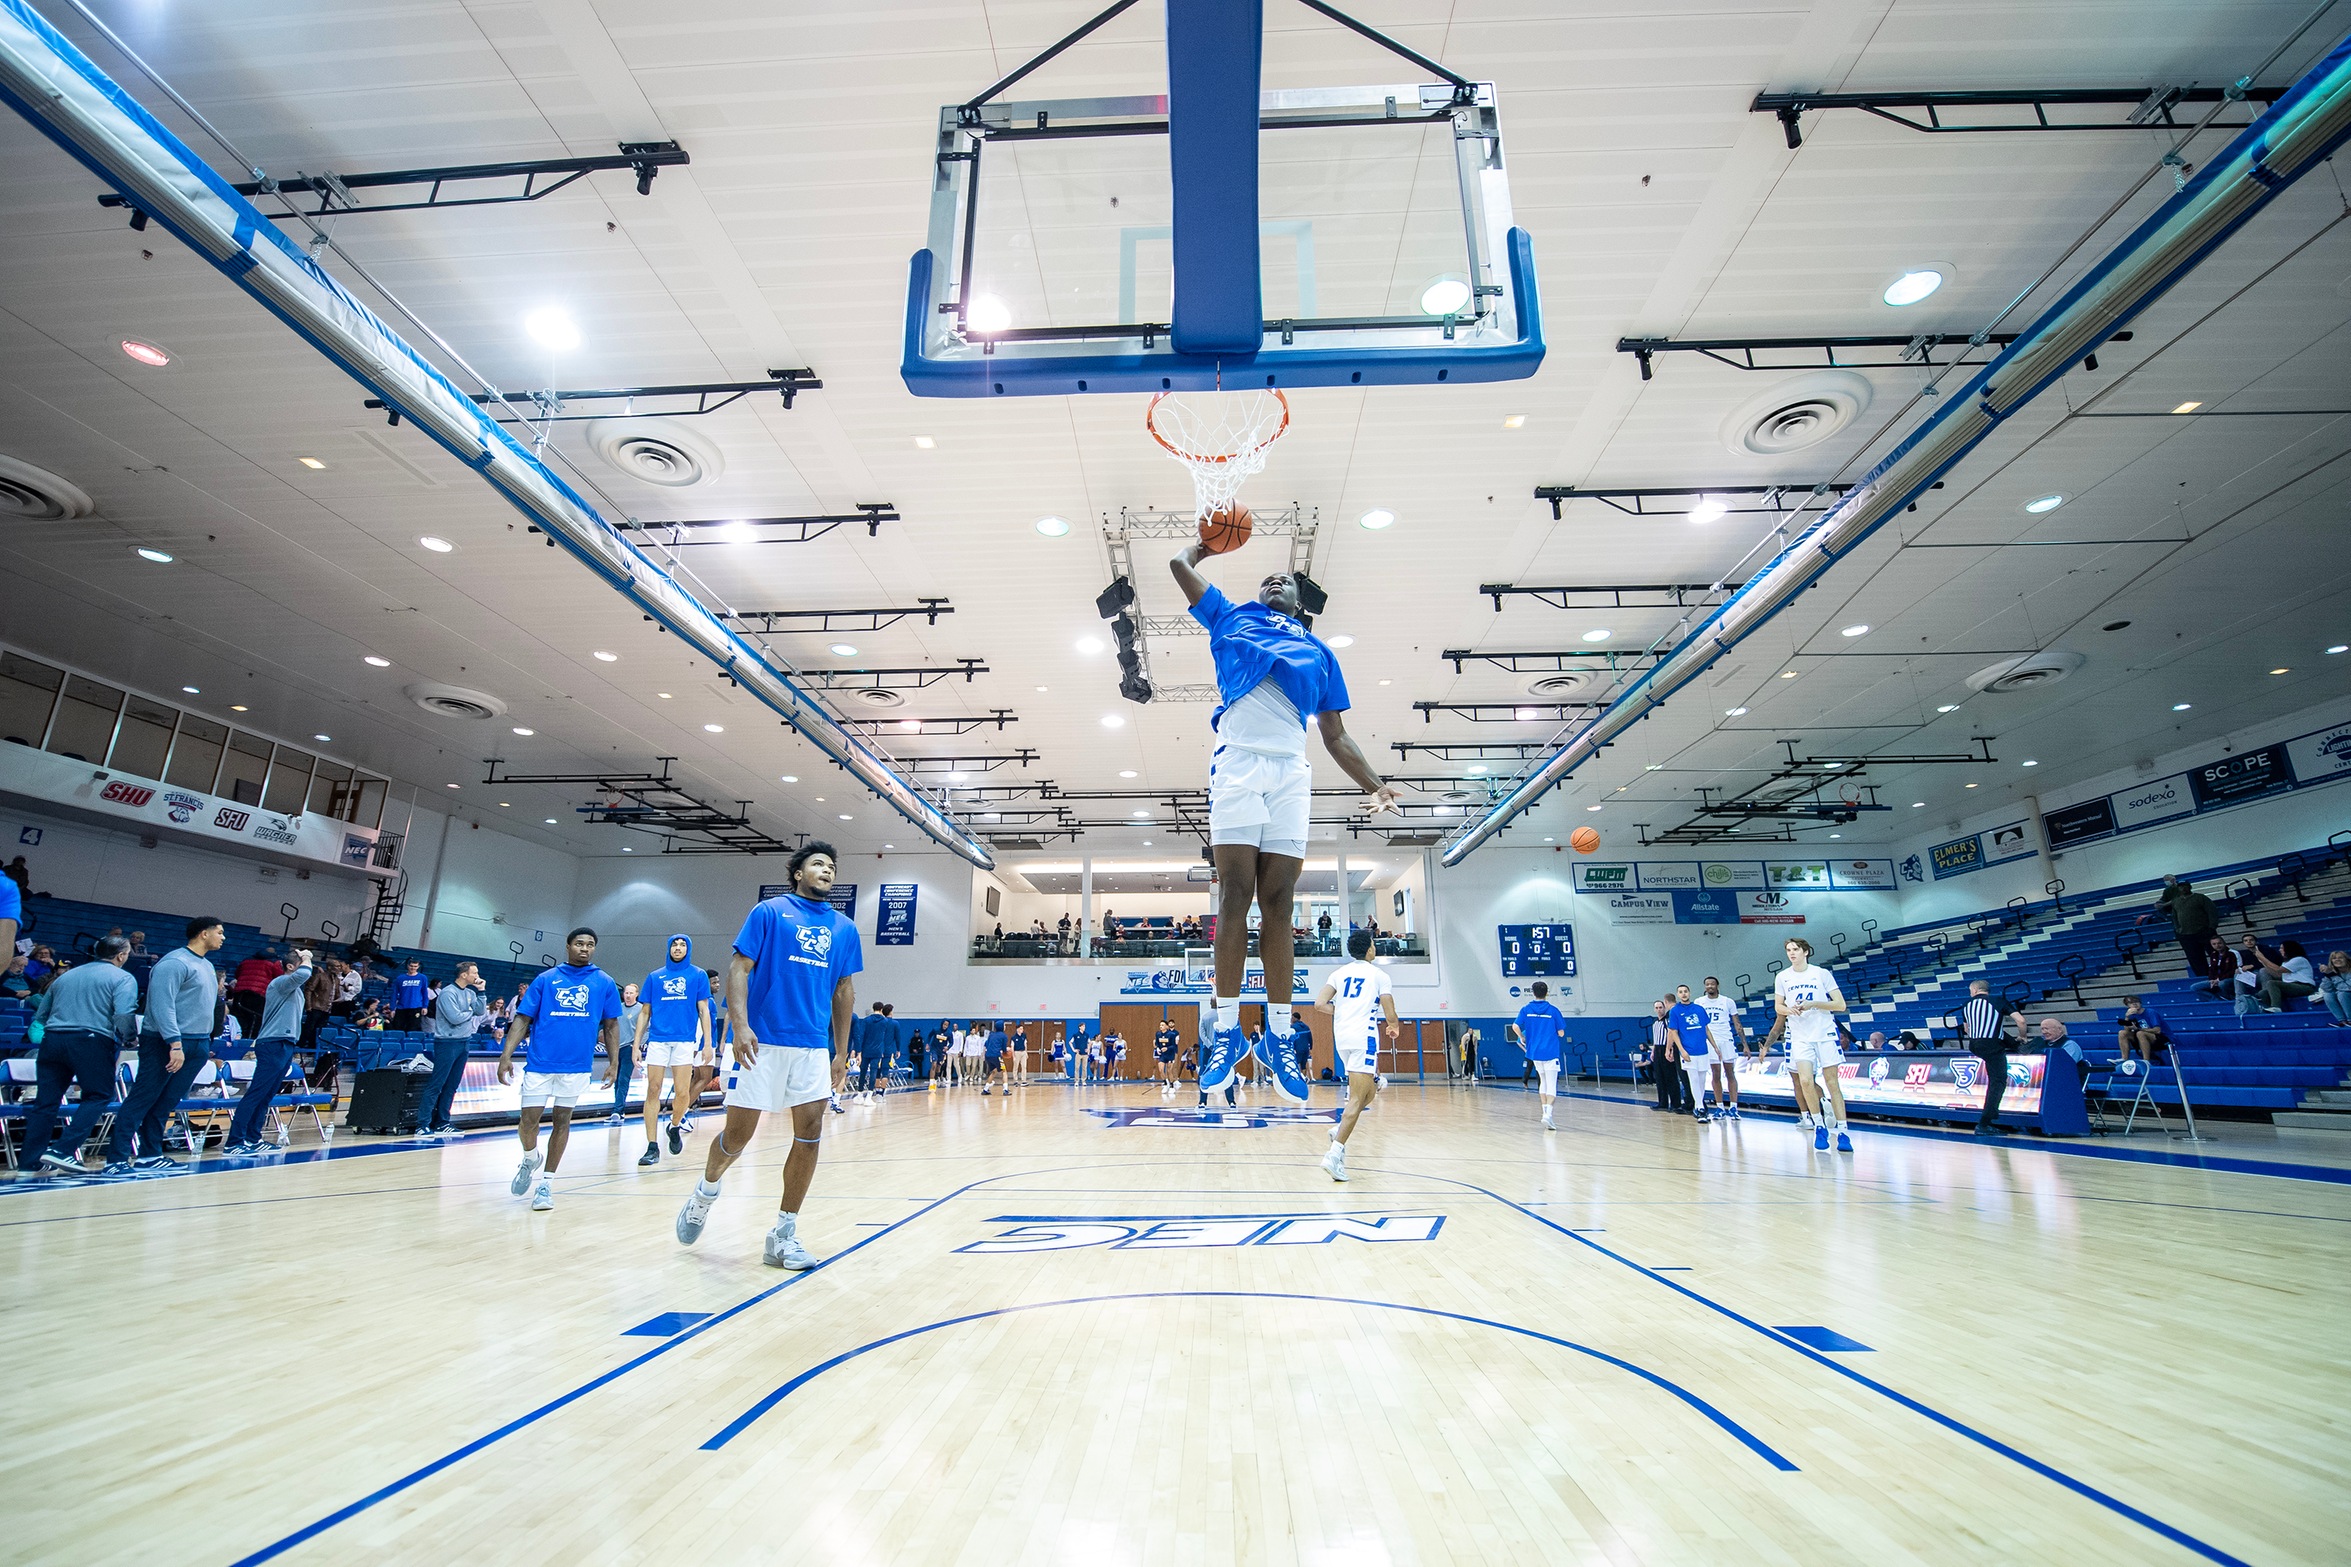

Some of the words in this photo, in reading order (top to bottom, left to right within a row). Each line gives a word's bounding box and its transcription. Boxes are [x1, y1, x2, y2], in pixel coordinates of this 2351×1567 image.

[2204, 753, 2272, 782] SCOPE
[101, 780, 157, 808] SHU
[2128, 789, 2176, 810] sodexo
[214, 807, 250, 831] SFU
[22, 828, 39, 845] 4
[255, 825, 298, 843] WAGNER
[345, 846, 368, 855] NEC
[1934, 839, 1977, 862] ELMER'S
[1939, 853, 1976, 869] PLACE
[1707, 867, 1729, 880] chili's
[1768, 865, 1826, 883] T&T
[1766, 892, 1781, 904] M
[1690, 903, 1720, 911] Allstate
[1512, 942, 1520, 954] 0
[1533, 944, 1541, 954] 0
[1562, 941, 1571, 954] 0
[788, 955, 829, 968] BASKETBALL
[1509, 961, 1516, 971] 0
[1567, 960, 1574, 970] 0
[1343, 976, 1366, 999] 13
[1787, 984, 1818, 992] CENTRAL
[1904, 1063, 1933, 1085] SFU
[949, 1215, 1448, 1254] NEC
